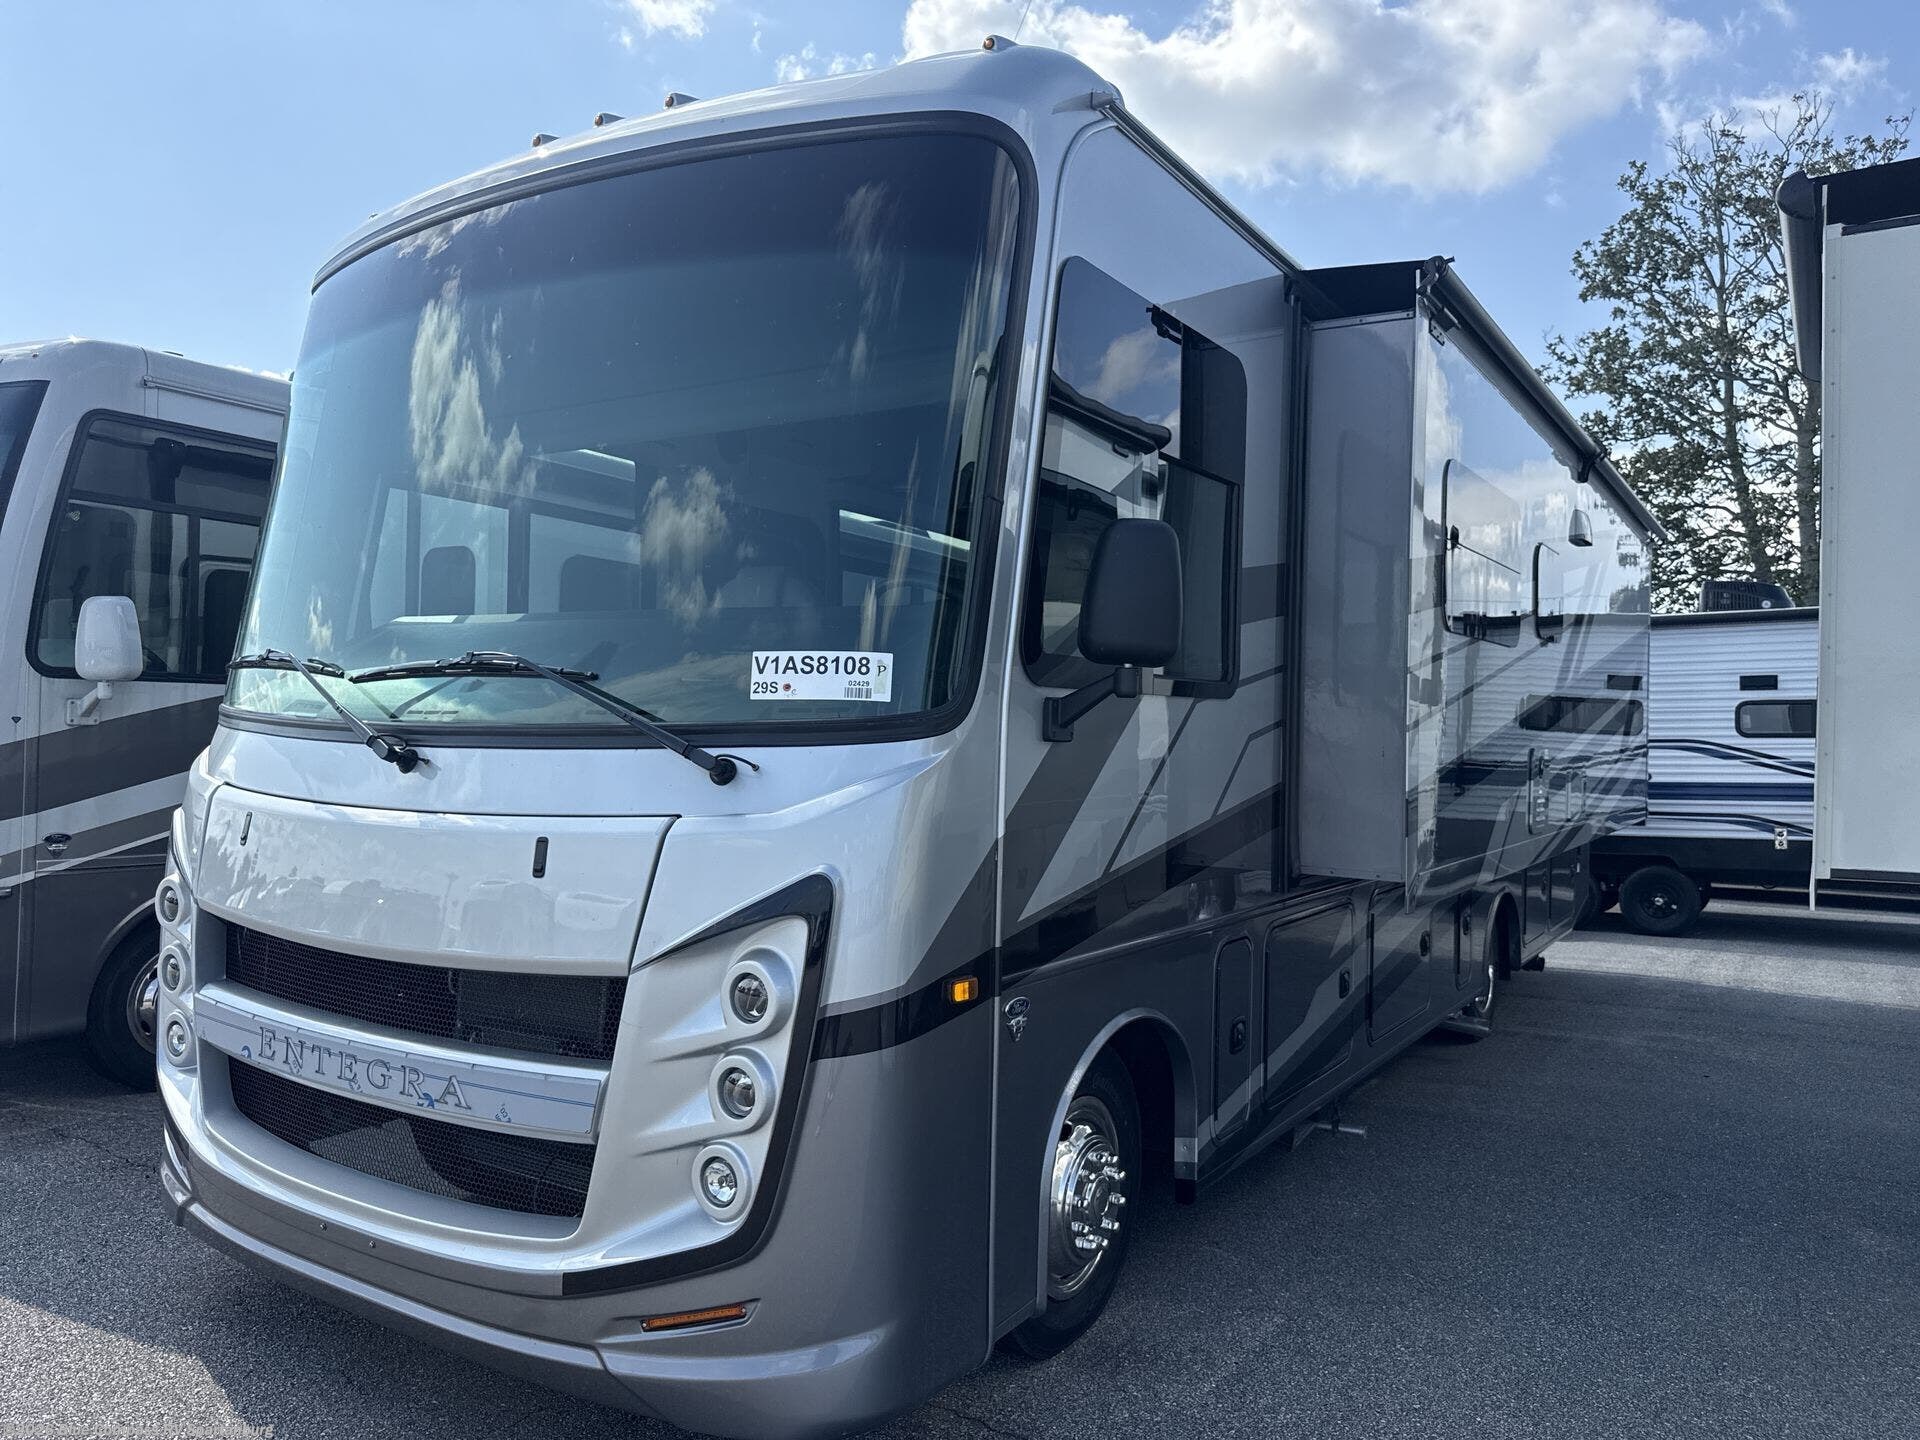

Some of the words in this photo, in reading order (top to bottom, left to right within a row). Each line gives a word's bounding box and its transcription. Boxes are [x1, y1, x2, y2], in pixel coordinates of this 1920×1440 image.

[754, 655, 871, 676] V1AS8108
[752, 682, 779, 694] 29S
[258, 1026, 471, 1110] ENTEGRA
